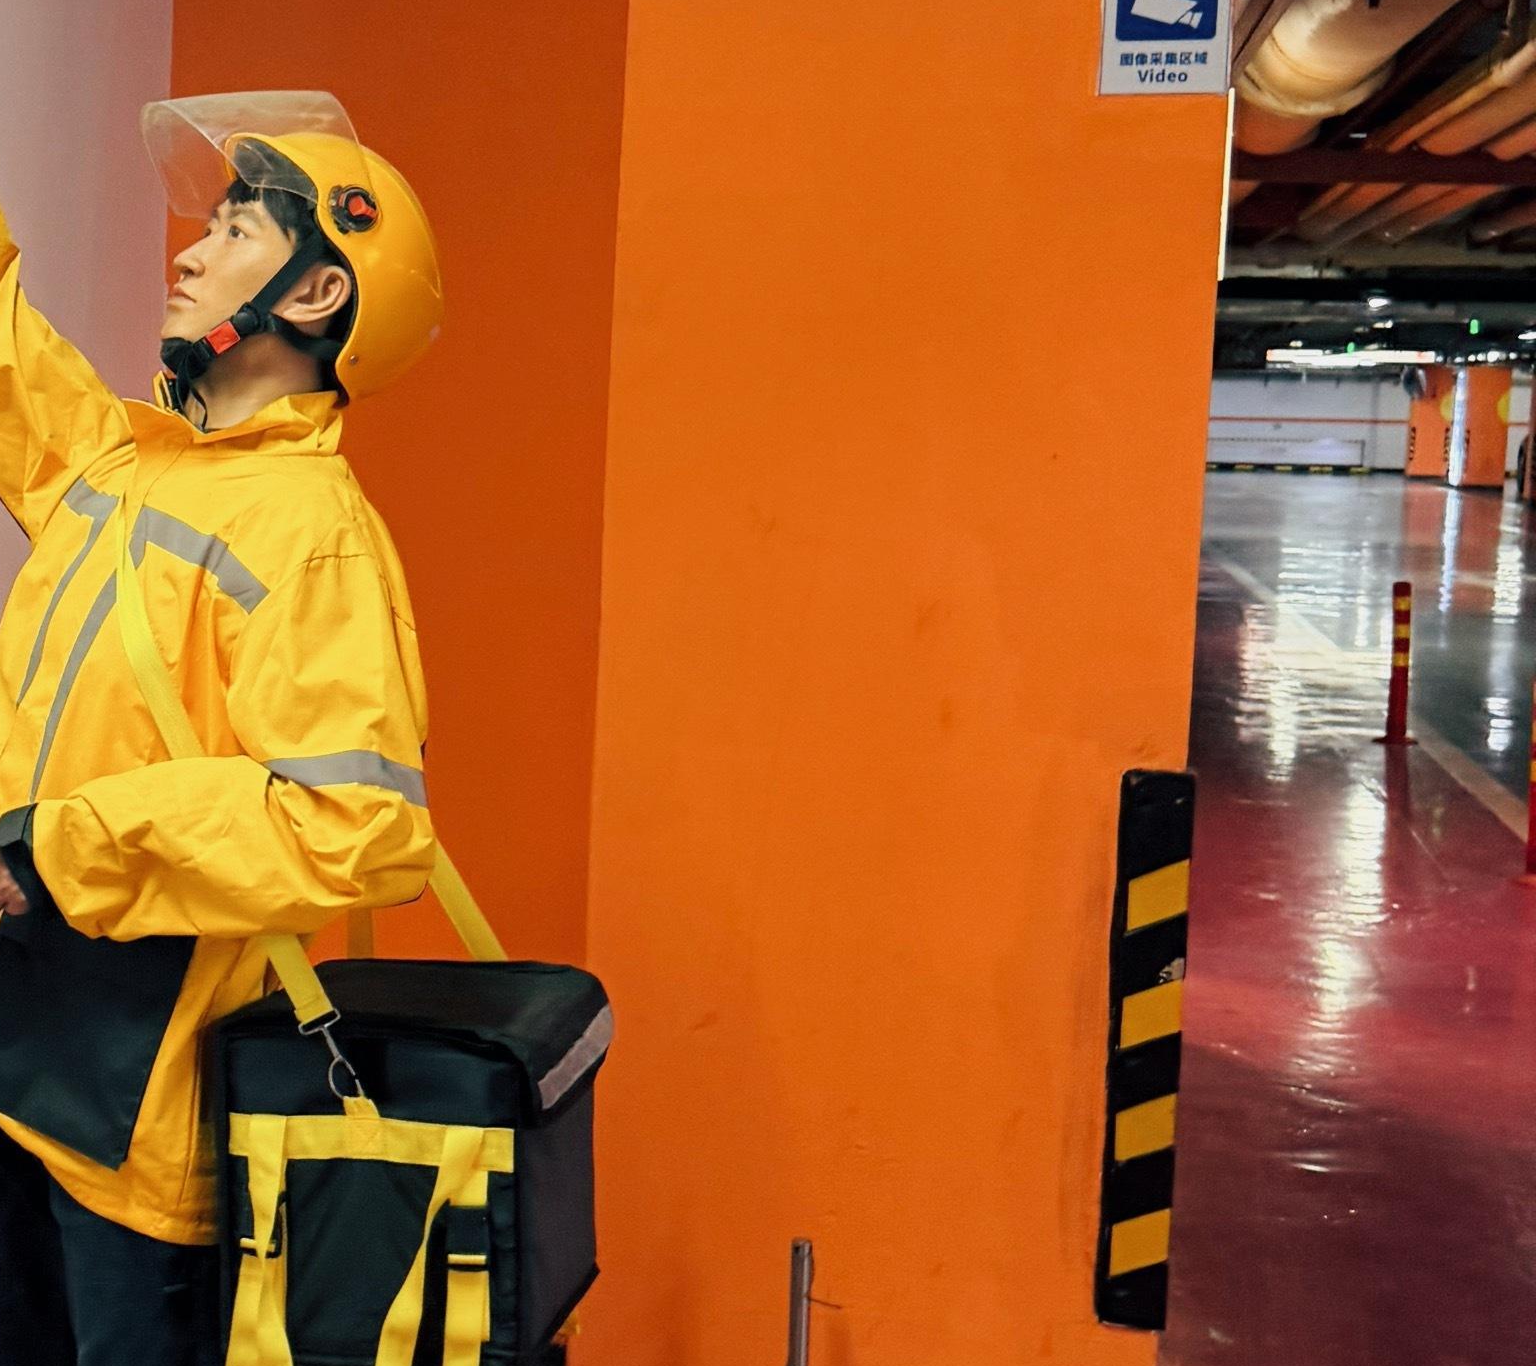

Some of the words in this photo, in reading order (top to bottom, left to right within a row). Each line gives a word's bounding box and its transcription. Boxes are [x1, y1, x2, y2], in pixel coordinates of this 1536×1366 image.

[1119, 51, 1208, 66] 图像采集区域
[1137, 69, 1188, 83] Video
